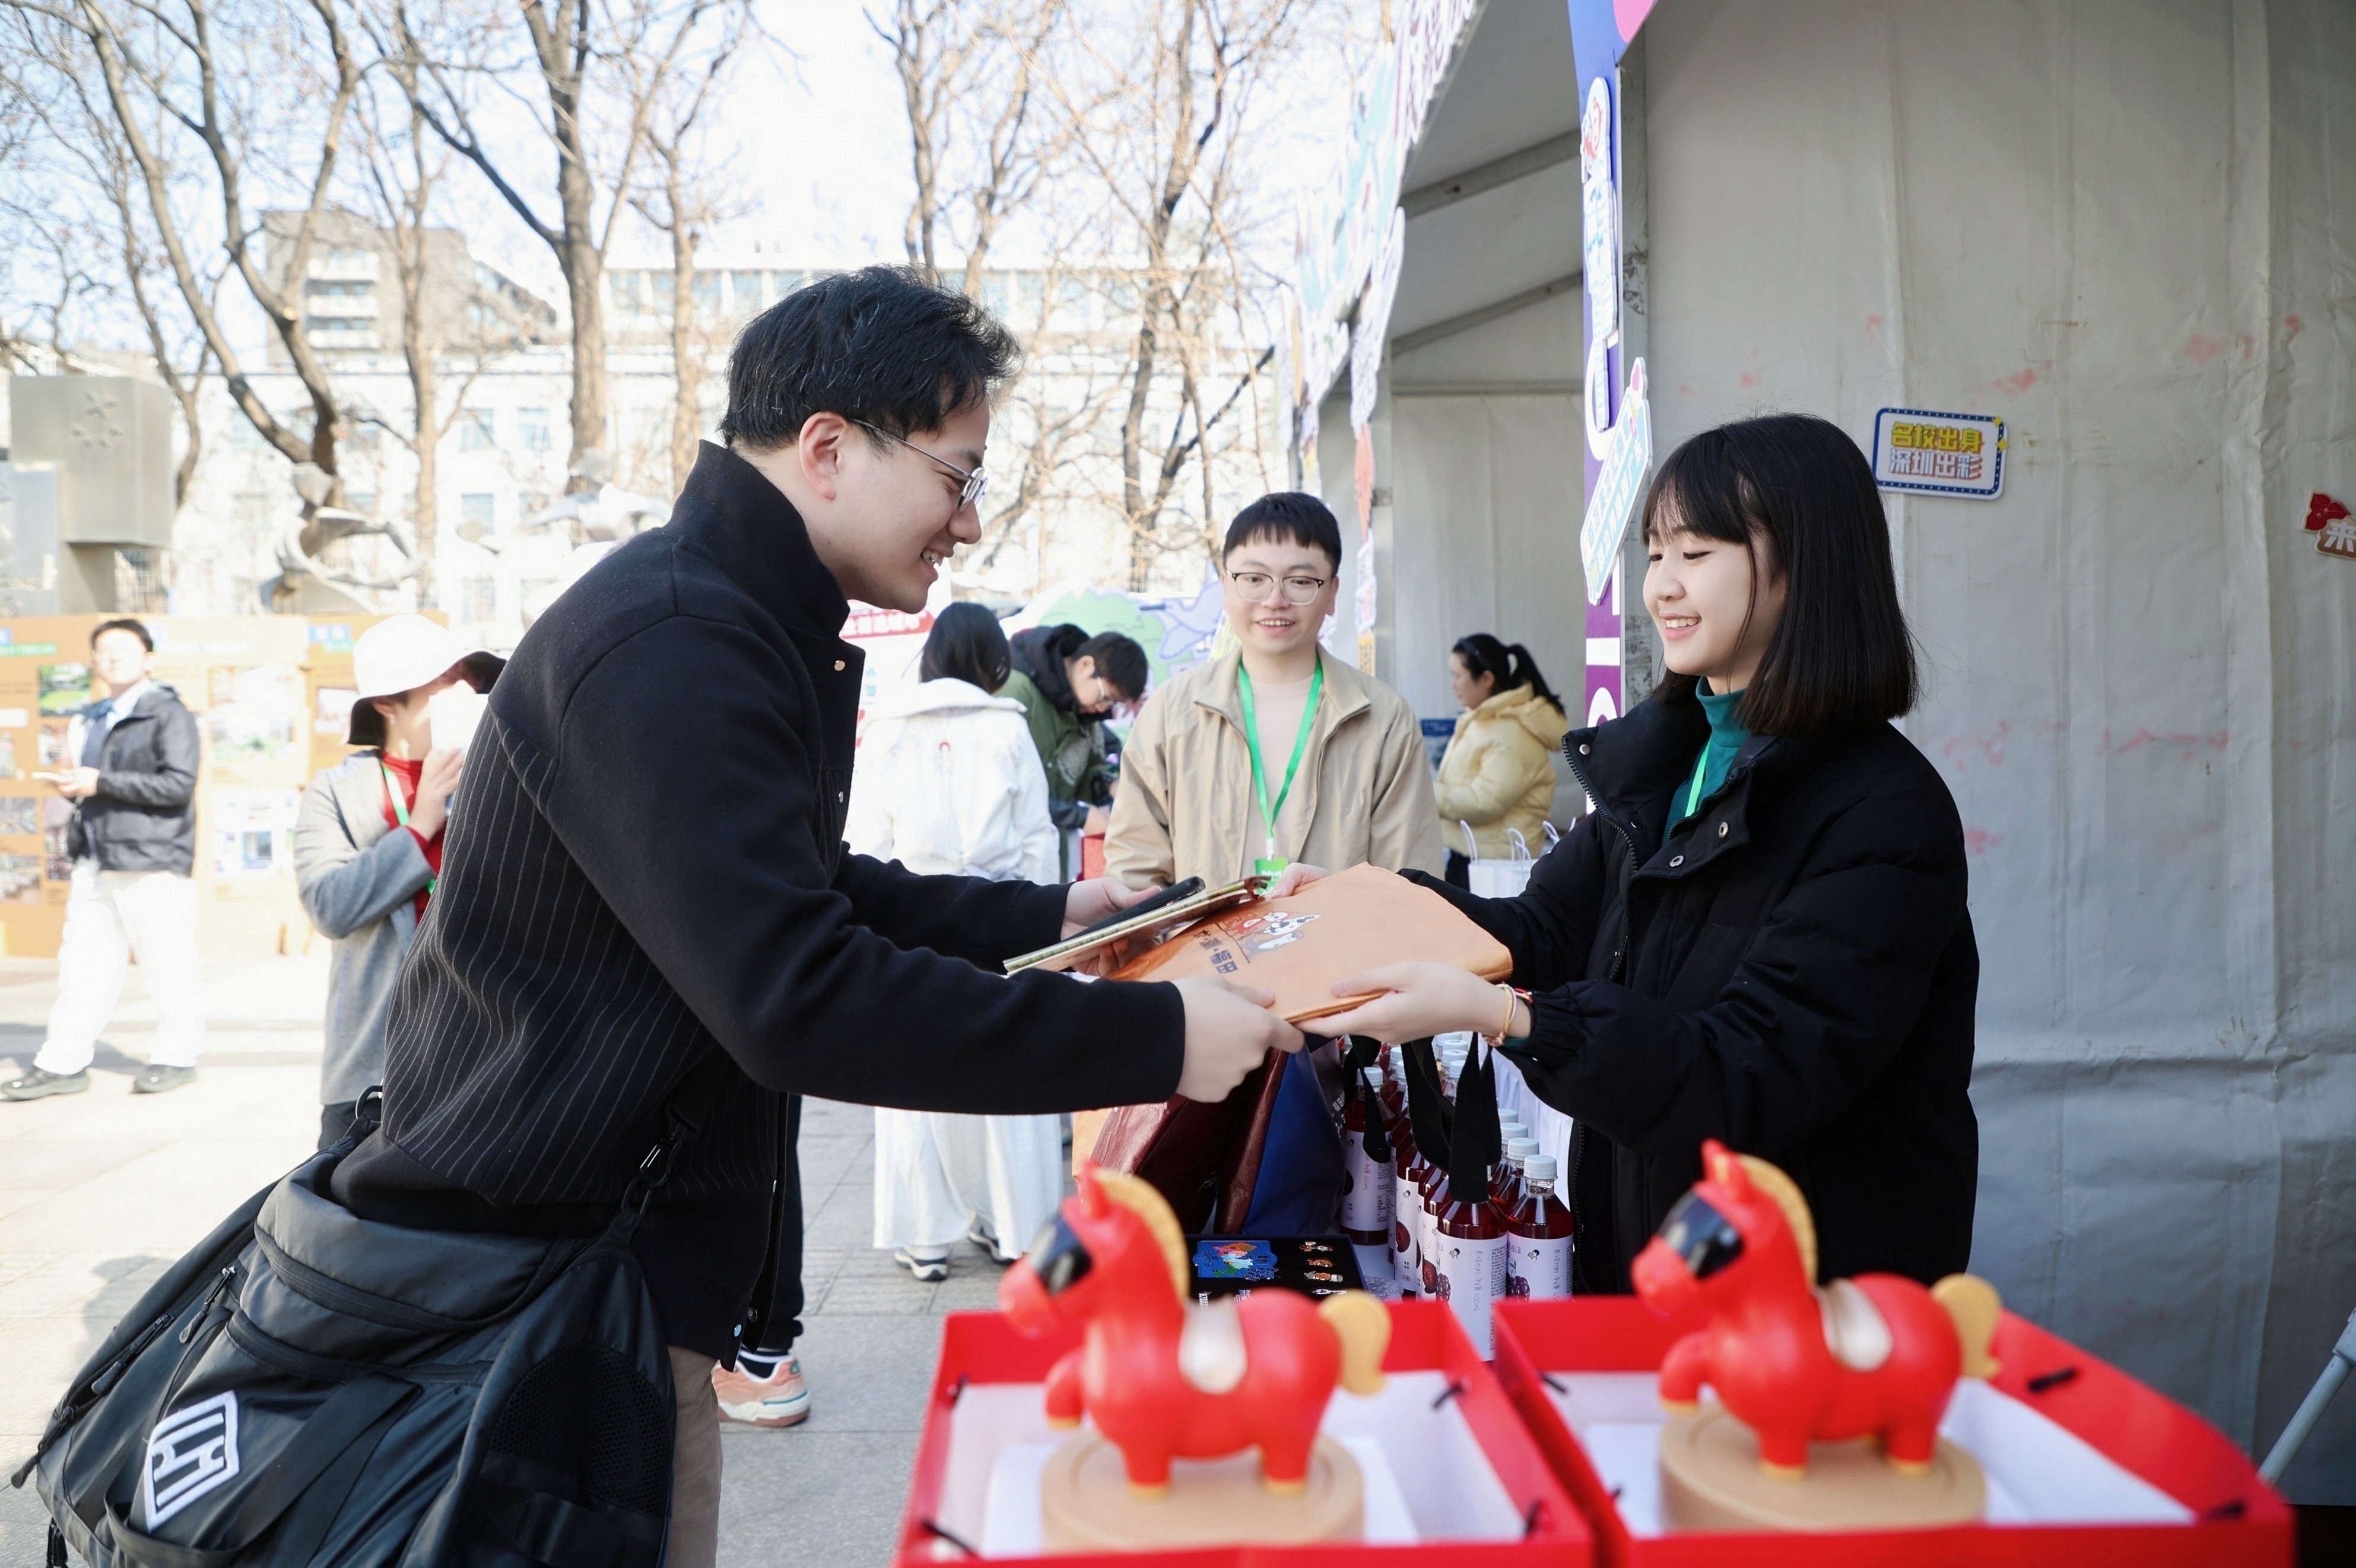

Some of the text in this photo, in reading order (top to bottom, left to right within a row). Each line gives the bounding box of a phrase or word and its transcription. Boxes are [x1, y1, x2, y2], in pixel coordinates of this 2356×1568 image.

[1891, 421, 1983, 454] 名校出身
[1890, 450, 1983, 481] 深圳出彩
